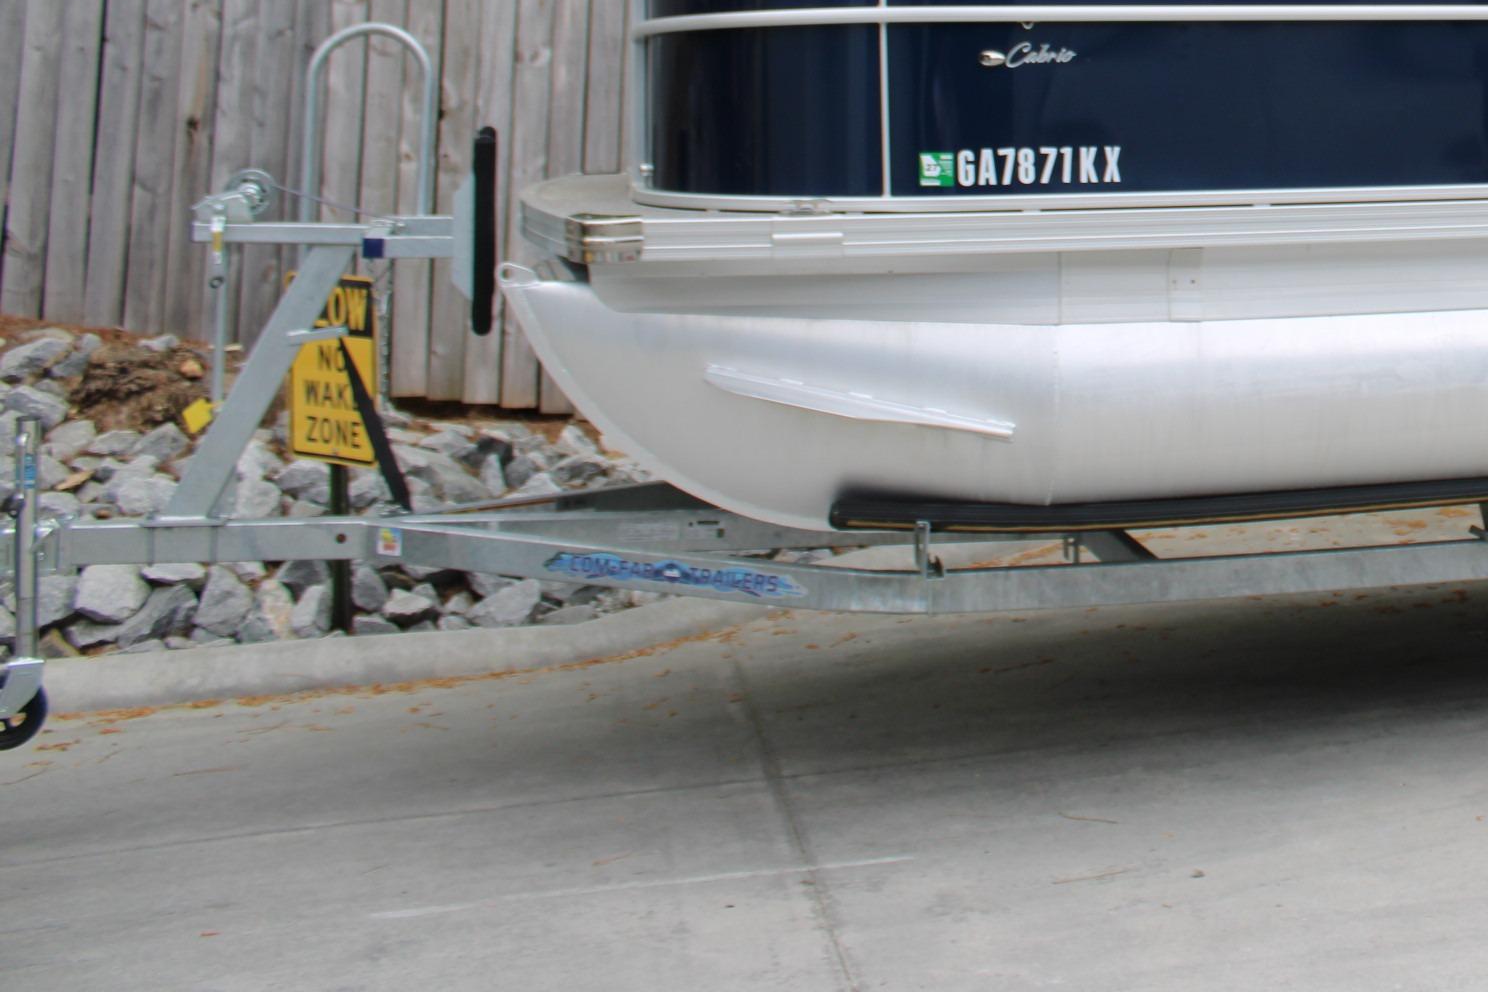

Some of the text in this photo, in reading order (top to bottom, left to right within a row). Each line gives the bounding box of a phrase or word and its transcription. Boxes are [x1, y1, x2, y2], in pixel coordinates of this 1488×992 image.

[1005, 41, 1077, 68] Cabrio
[957, 145, 1121, 186] GA7871KX
[304, 379, 357, 411] WAK
[307, 416, 361, 449] ZONE
[690, 566, 779, 592] TRAILERS
